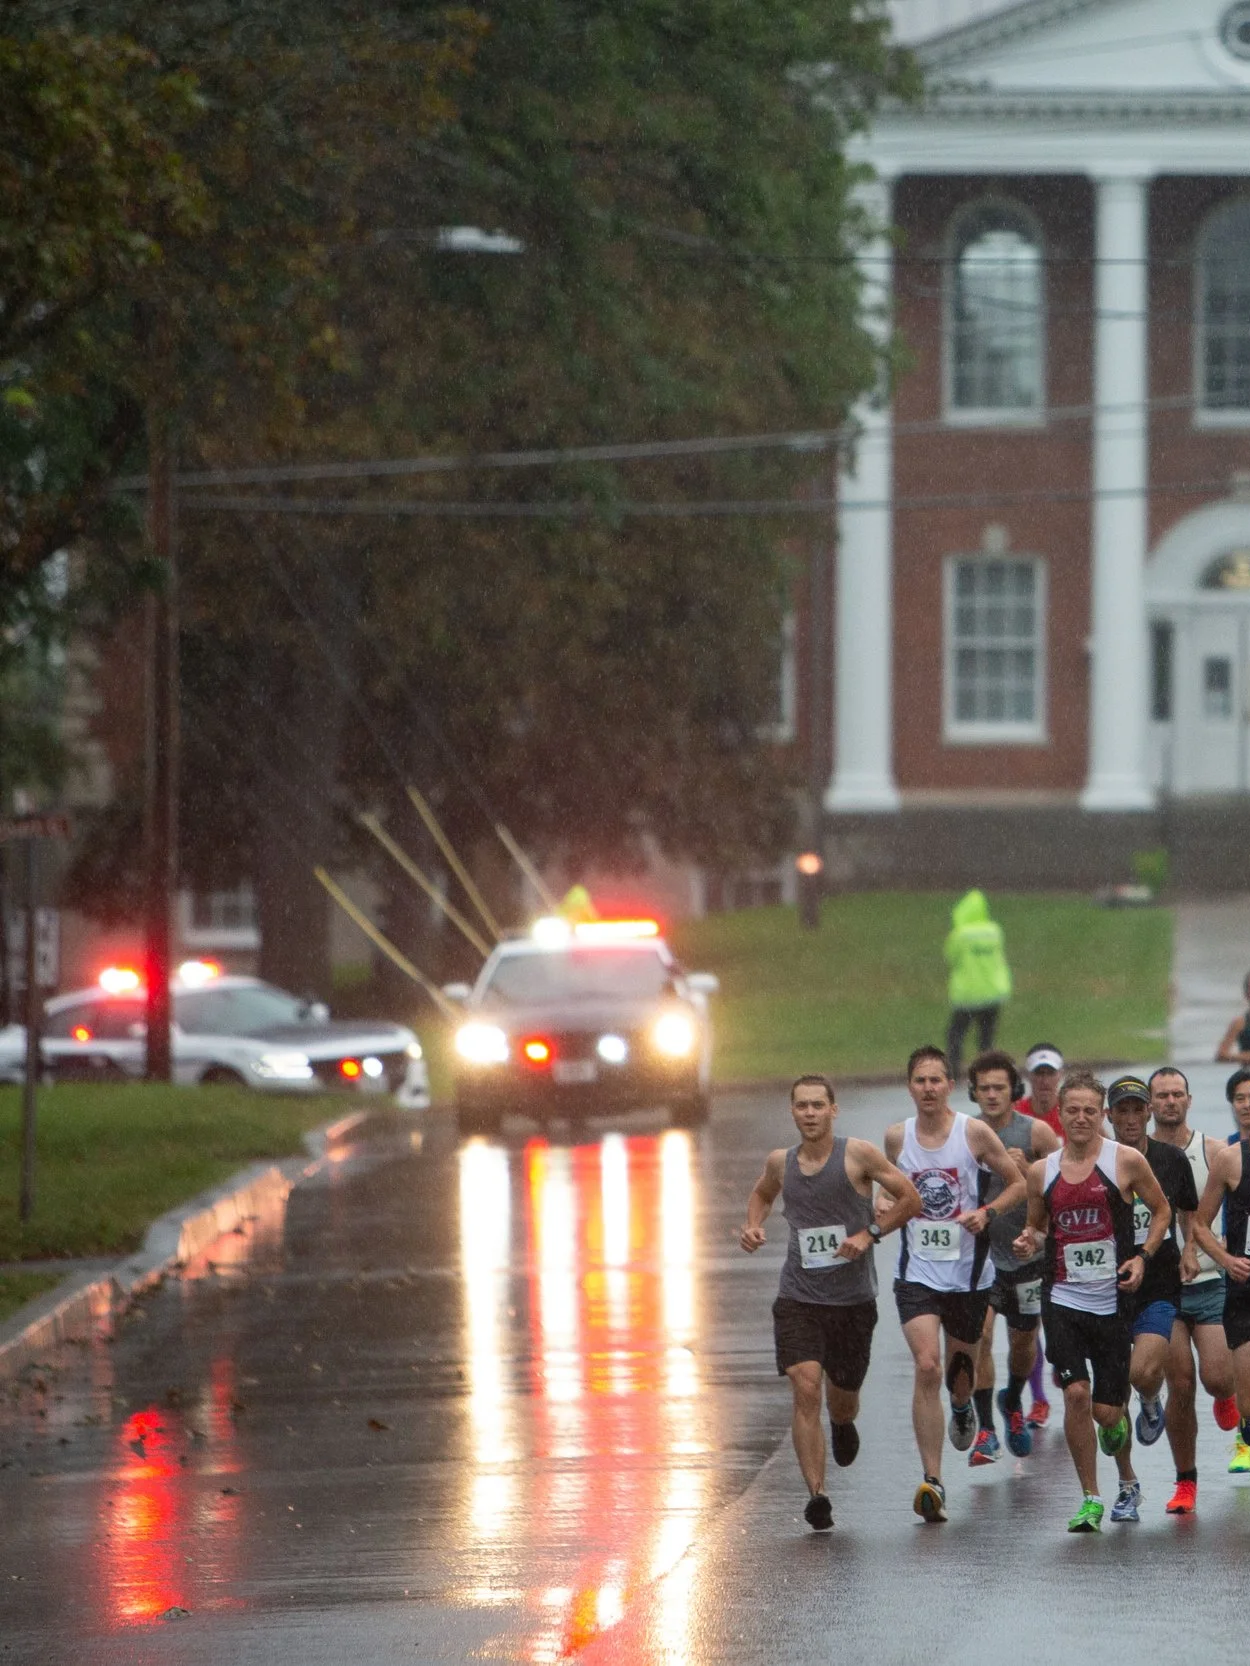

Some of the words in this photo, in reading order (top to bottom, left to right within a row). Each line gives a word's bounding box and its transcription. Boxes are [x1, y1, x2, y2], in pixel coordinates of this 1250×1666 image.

[1058, 1207, 1099, 1227] GVH
[1132, 1211, 1151, 1230] 32
[807, 1233, 839, 1253] 214
[921, 1229, 951, 1247] 343
[1074, 1248, 1106, 1267] 342
